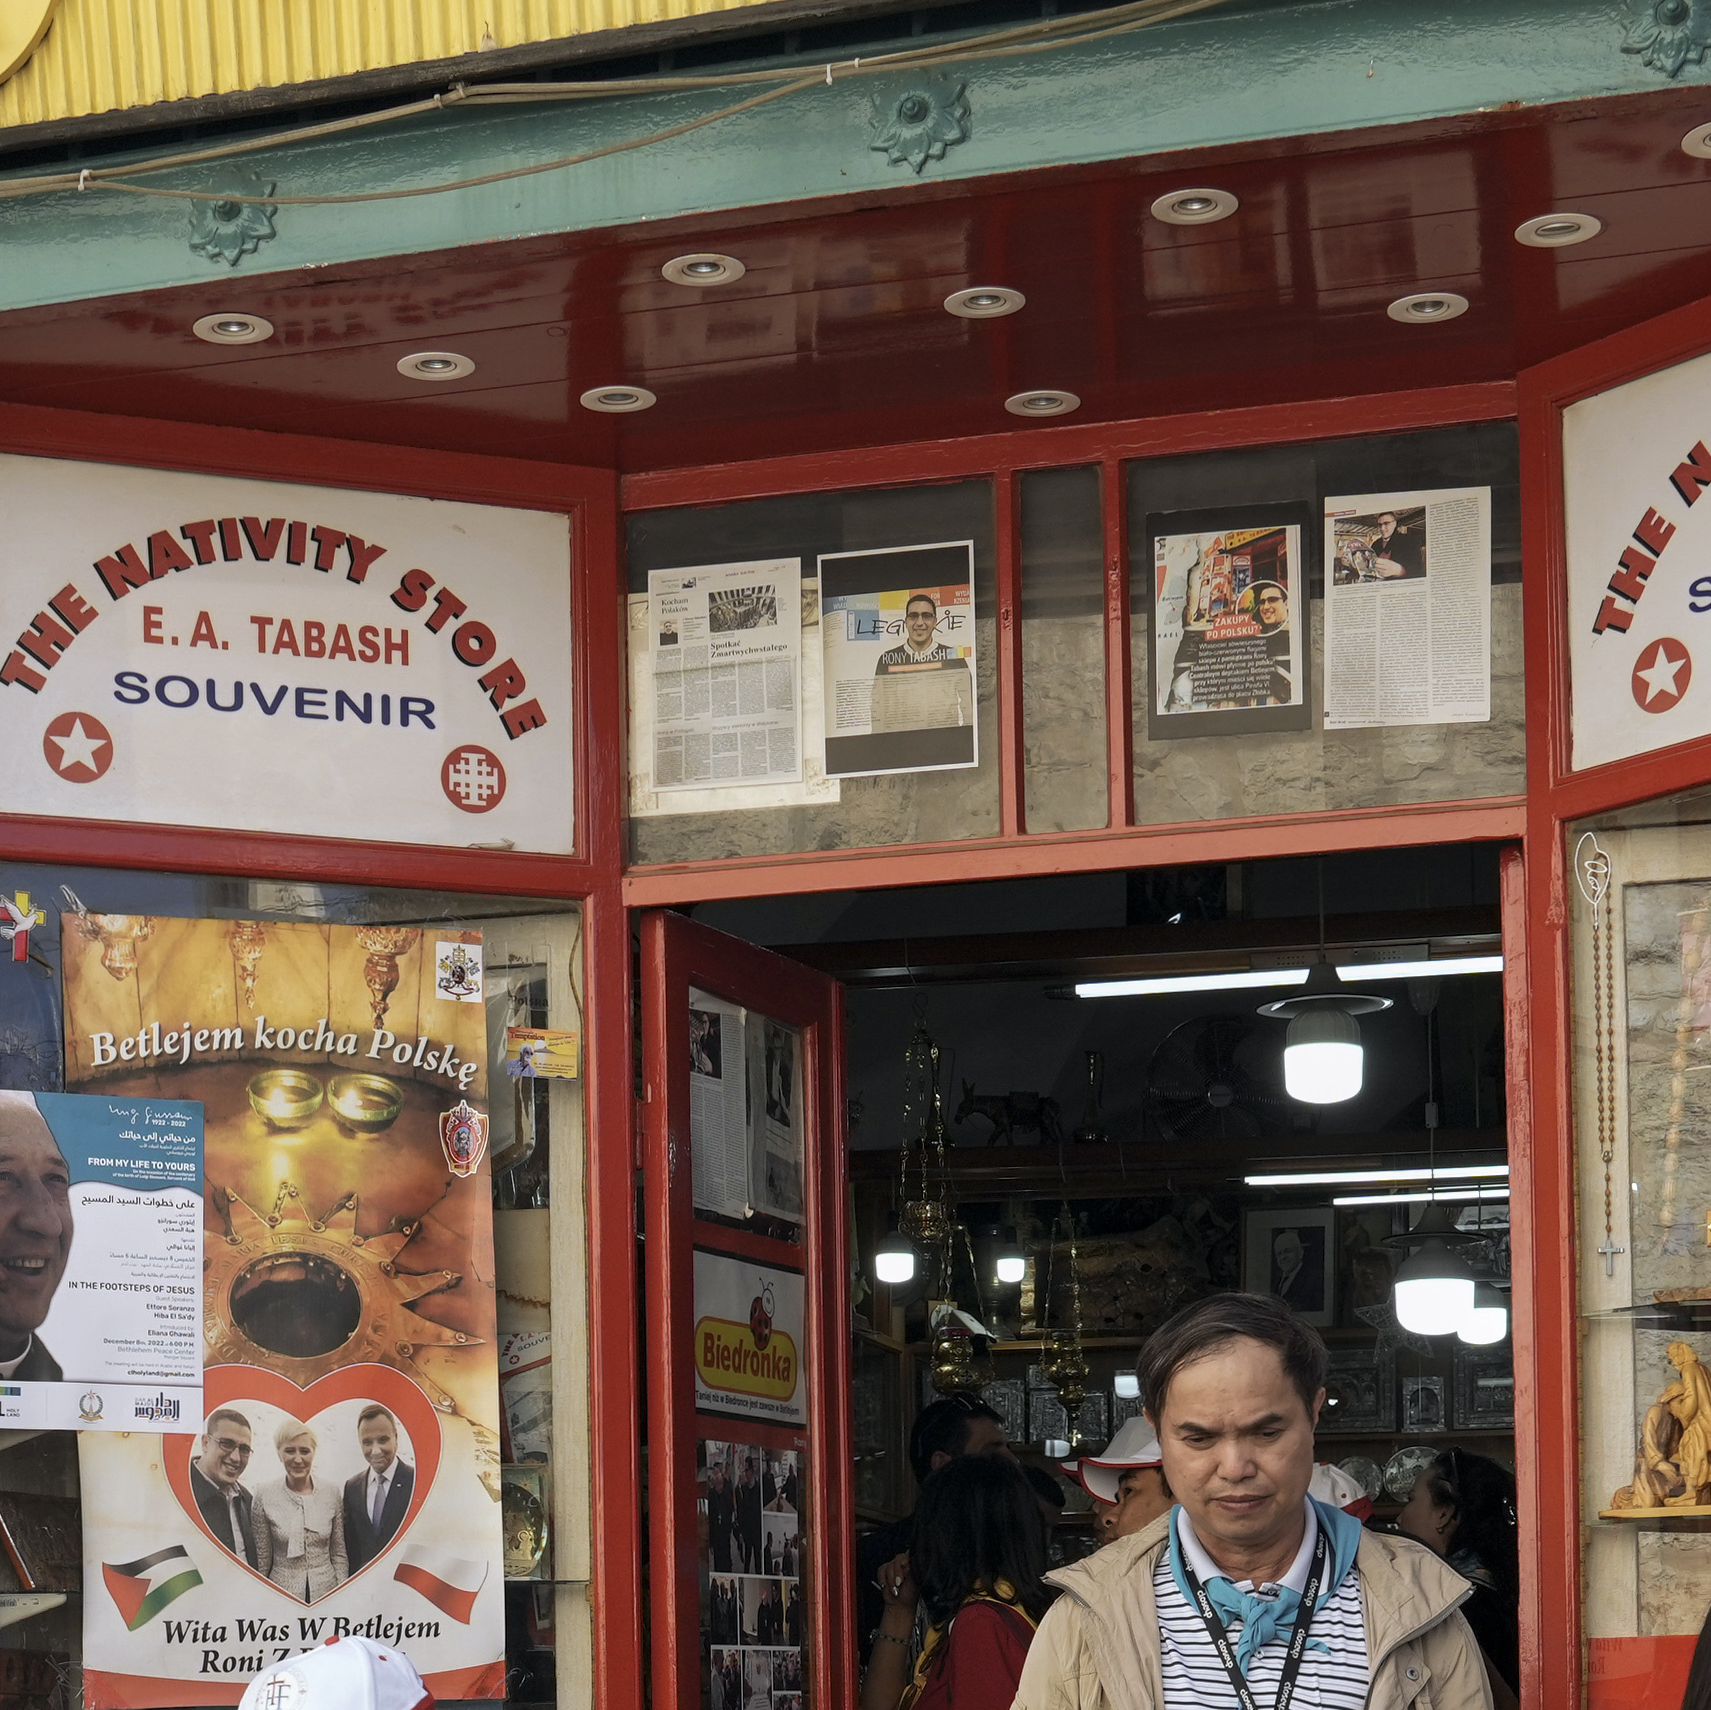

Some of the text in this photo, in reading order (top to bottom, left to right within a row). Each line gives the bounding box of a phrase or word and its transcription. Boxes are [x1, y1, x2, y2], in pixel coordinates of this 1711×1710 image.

[1592, 506, 1676, 636] THE
[661, 598, 688, 606] Kocham
[94, 516, 387, 601] NATIVITY
[391, 568, 548, 740] STORE
[1206, 625, 1260, 638] PO POLSKU?
[1215, 615, 1250, 626] ZAKUPY
[142, 606, 409, 665] E. A. TABASH
[710, 640, 741, 650] Spotkać
[882, 650, 946, 664] RONY TABASH
[114, 671, 436, 729] SOUVENIR
[90, 1016, 478, 1091] Betlejem kocha Polskę
[88, 1158, 113, 1166] FROM
[115, 1159, 129, 1167] MY
[130, 1160, 149, 1168] LIFE
[165, 1163, 195, 1171] YOURS
[81, 1195, 195, 1209] على خطوات السيد المسيح
[68, 1281, 195, 1295] IN THE FOOTSTEPS OF JESUS
[703, 1331, 791, 1384] Biedronka
[725, 1395, 759, 1410] Biedronce jest
[1196, 1590, 1213, 1619] closeup
[1306, 1577, 1319, 1607] closeup
[163, 1614, 442, 1648] Wita Was W Betlejem
[1292, 1628, 1306, 1659] closeup
[199, 1649, 264, 1674] Roni
[1218, 1639, 1233, 1669] closeup
